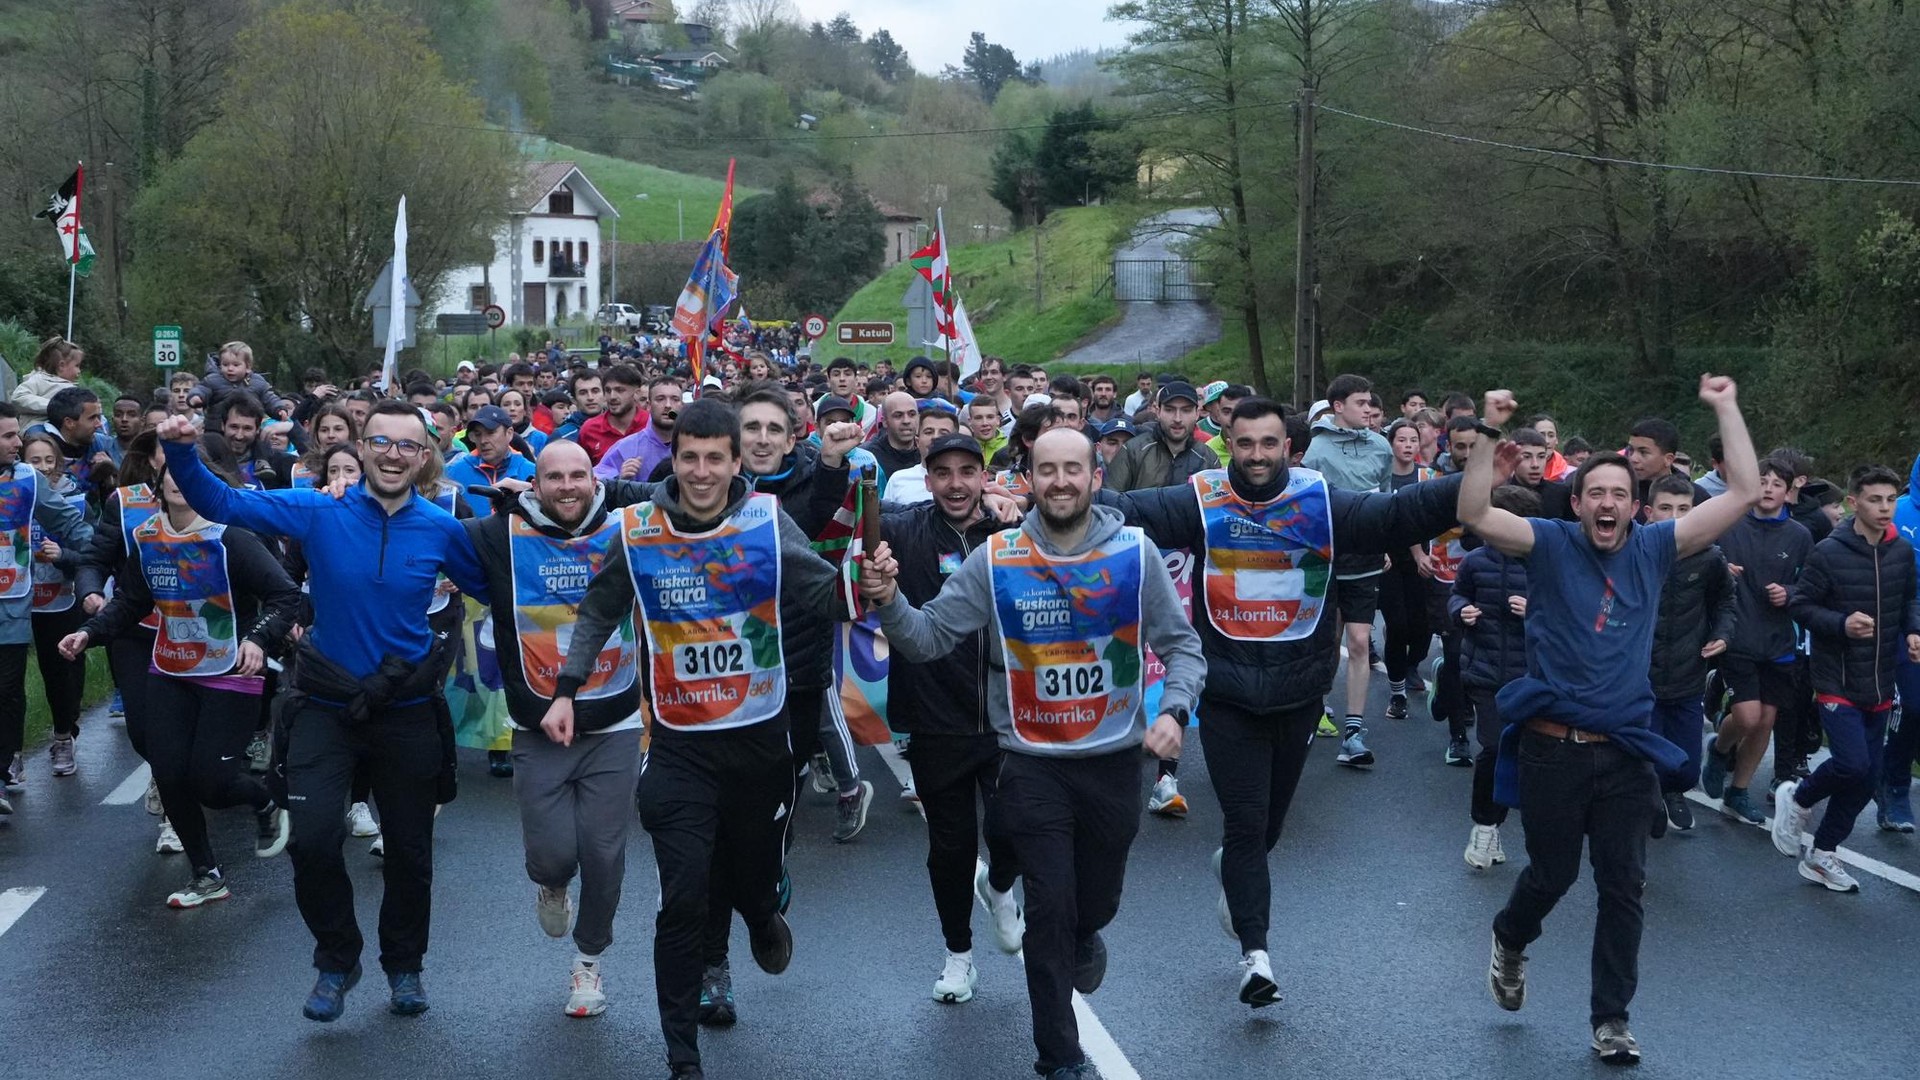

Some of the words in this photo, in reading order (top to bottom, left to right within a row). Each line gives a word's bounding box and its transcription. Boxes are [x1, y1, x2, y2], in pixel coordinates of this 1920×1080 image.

[488, 313, 500, 321] 70
[809, 322, 822, 332] 70
[859, 328, 891, 338] Katuin
[158, 351, 177, 362] 30
[742, 508, 768, 520] eitb
[539, 563, 588, 576] Euskara
[152, 575, 178, 589] gara
[546, 575, 589, 593] gara
[652, 574, 705, 589] Euskara
[659, 586, 706, 610] gara
[1015, 597, 1069, 611] Euskara
[1022, 609, 1071, 631] gara
[1214, 605, 1288, 622] 24.korrika
[684, 643, 744, 675] 3102
[1045, 665, 1105, 697] 3102
[658, 682, 739, 706] 24.korrika
[1017, 705, 1096, 725] 24.korrika
